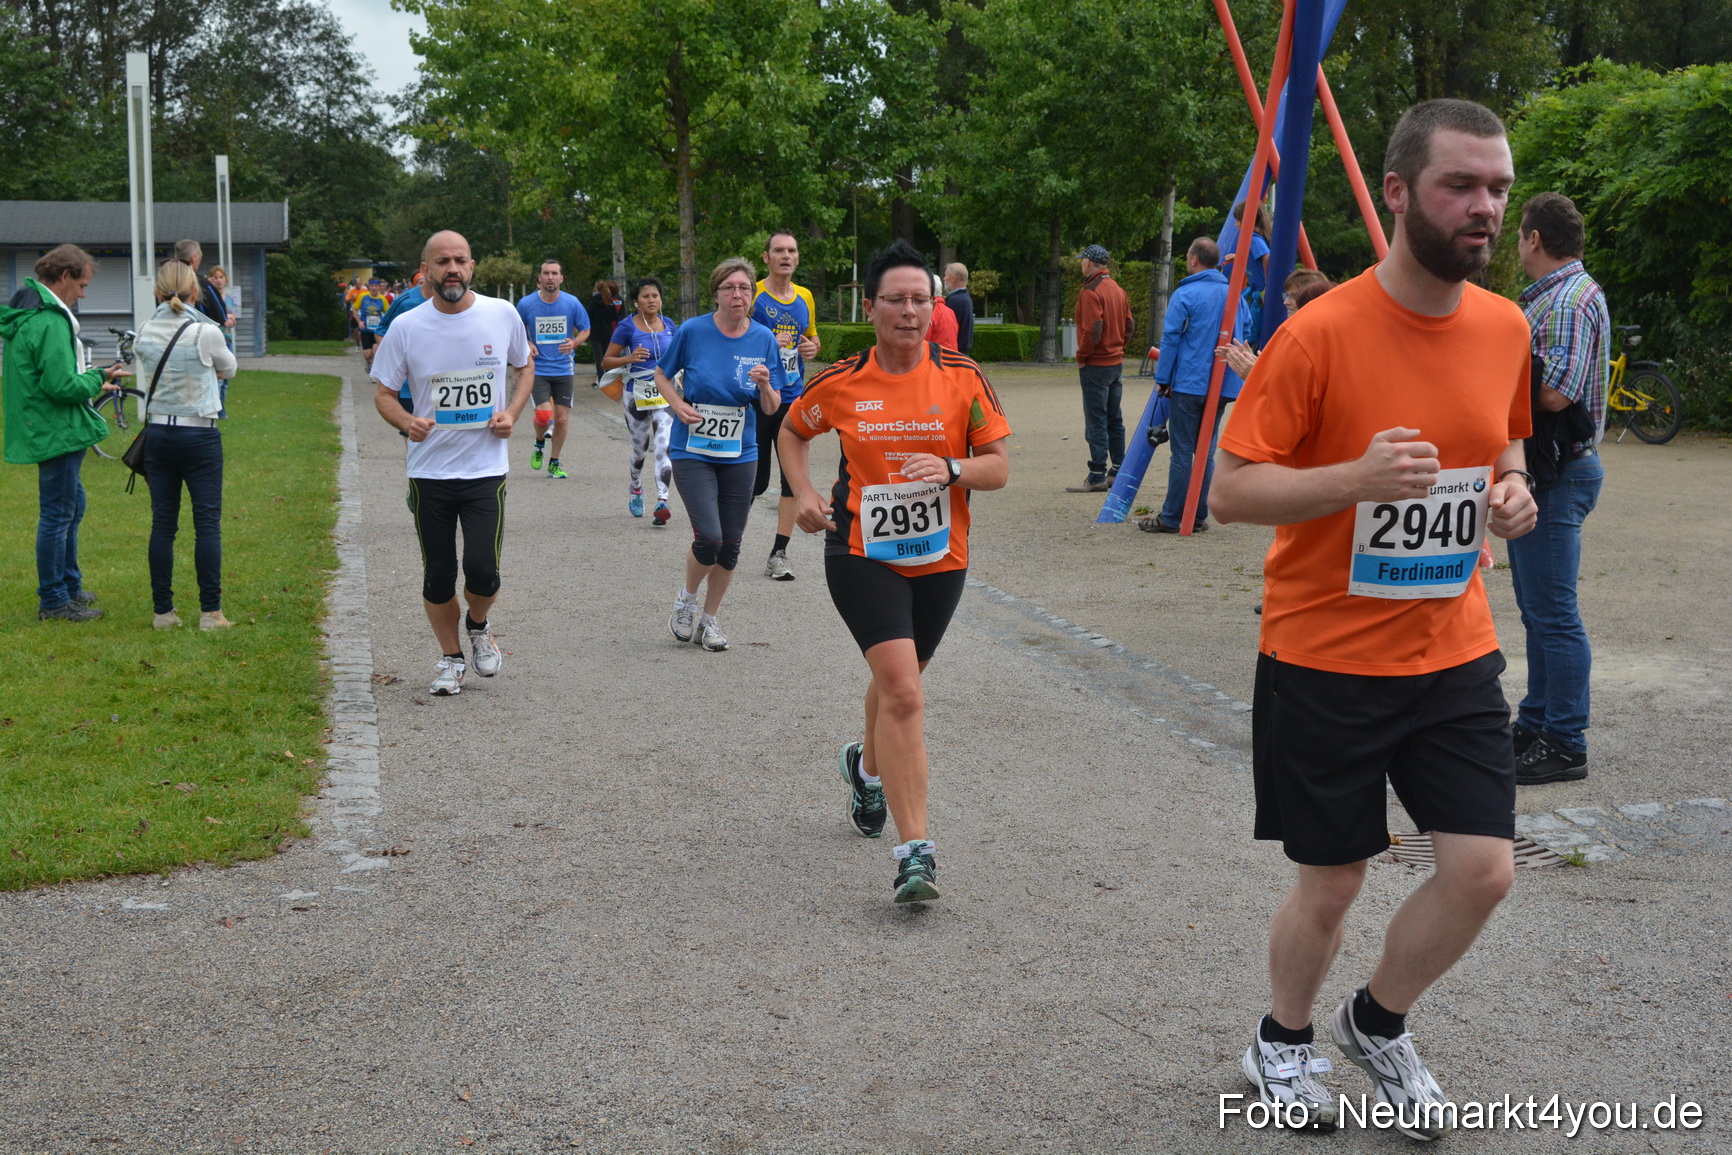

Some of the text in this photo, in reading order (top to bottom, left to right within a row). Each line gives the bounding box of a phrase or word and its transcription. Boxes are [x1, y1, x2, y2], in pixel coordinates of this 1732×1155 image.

[539, 322, 565, 334] 2255
[431, 375, 485, 384] PARTL Neumarkt
[439, 383, 492, 408] 2769
[855, 400, 884, 412] DAK
[455, 412, 478, 421] Peter
[695, 416, 740, 438] 2267
[857, 419, 945, 434] SportScheck
[707, 441, 724, 450] Anni
[862, 487, 938, 503] PARTL Neumarkt
[1430, 481, 1469, 496] umarkt
[871, 496, 943, 538] 2931
[1369, 499, 1476, 551] 2940
[897, 540, 931, 556] Birgit
[1358, 544, 1365, 553] D
[1378, 560, 1464, 582] Ferdinand
